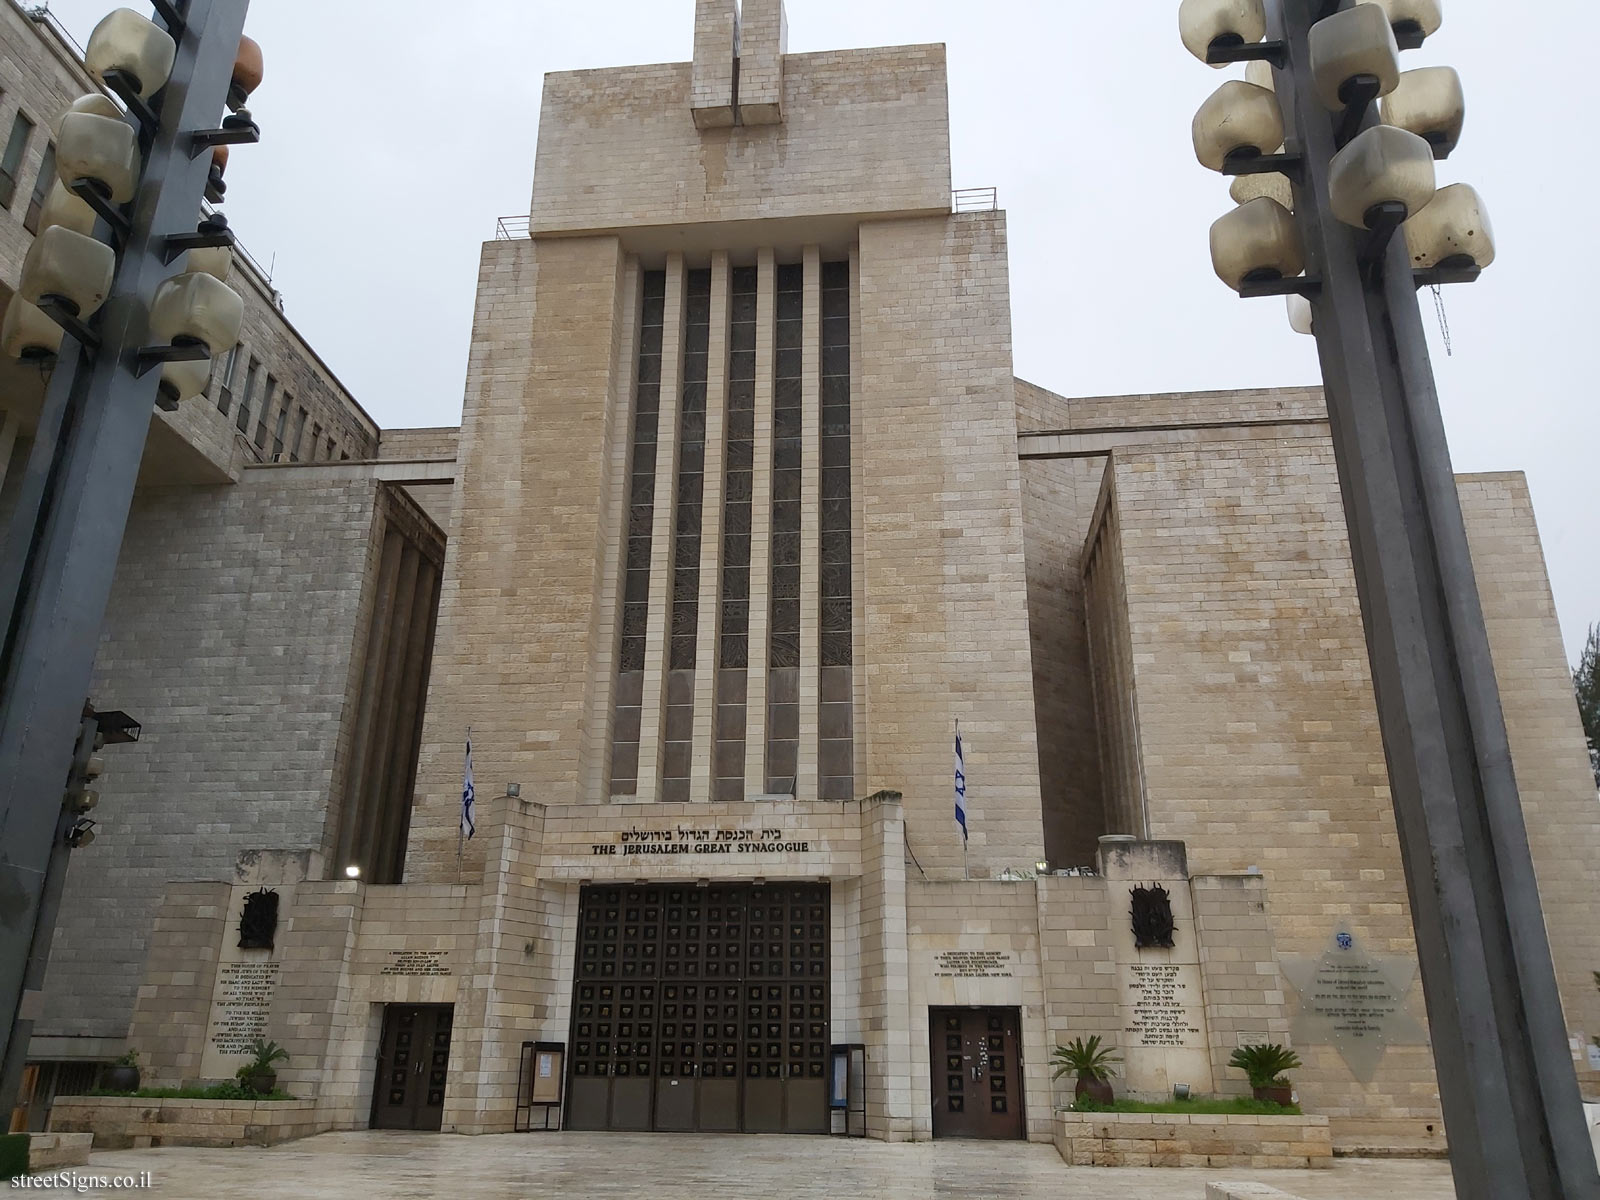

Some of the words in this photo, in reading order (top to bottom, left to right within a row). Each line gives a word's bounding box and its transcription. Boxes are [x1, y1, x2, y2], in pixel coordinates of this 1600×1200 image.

[621, 826, 672, 841] בירושלים
[677, 825, 710, 841] הגדול
[715, 829, 754, 840] הכנסת
[760, 828, 782, 840] בית
[592, 845, 616, 855] THE
[623, 844, 689, 856] JERUSALEM
[694, 843, 732, 854] GREAT
[737, 842, 809, 853] SYNAGOGUE
